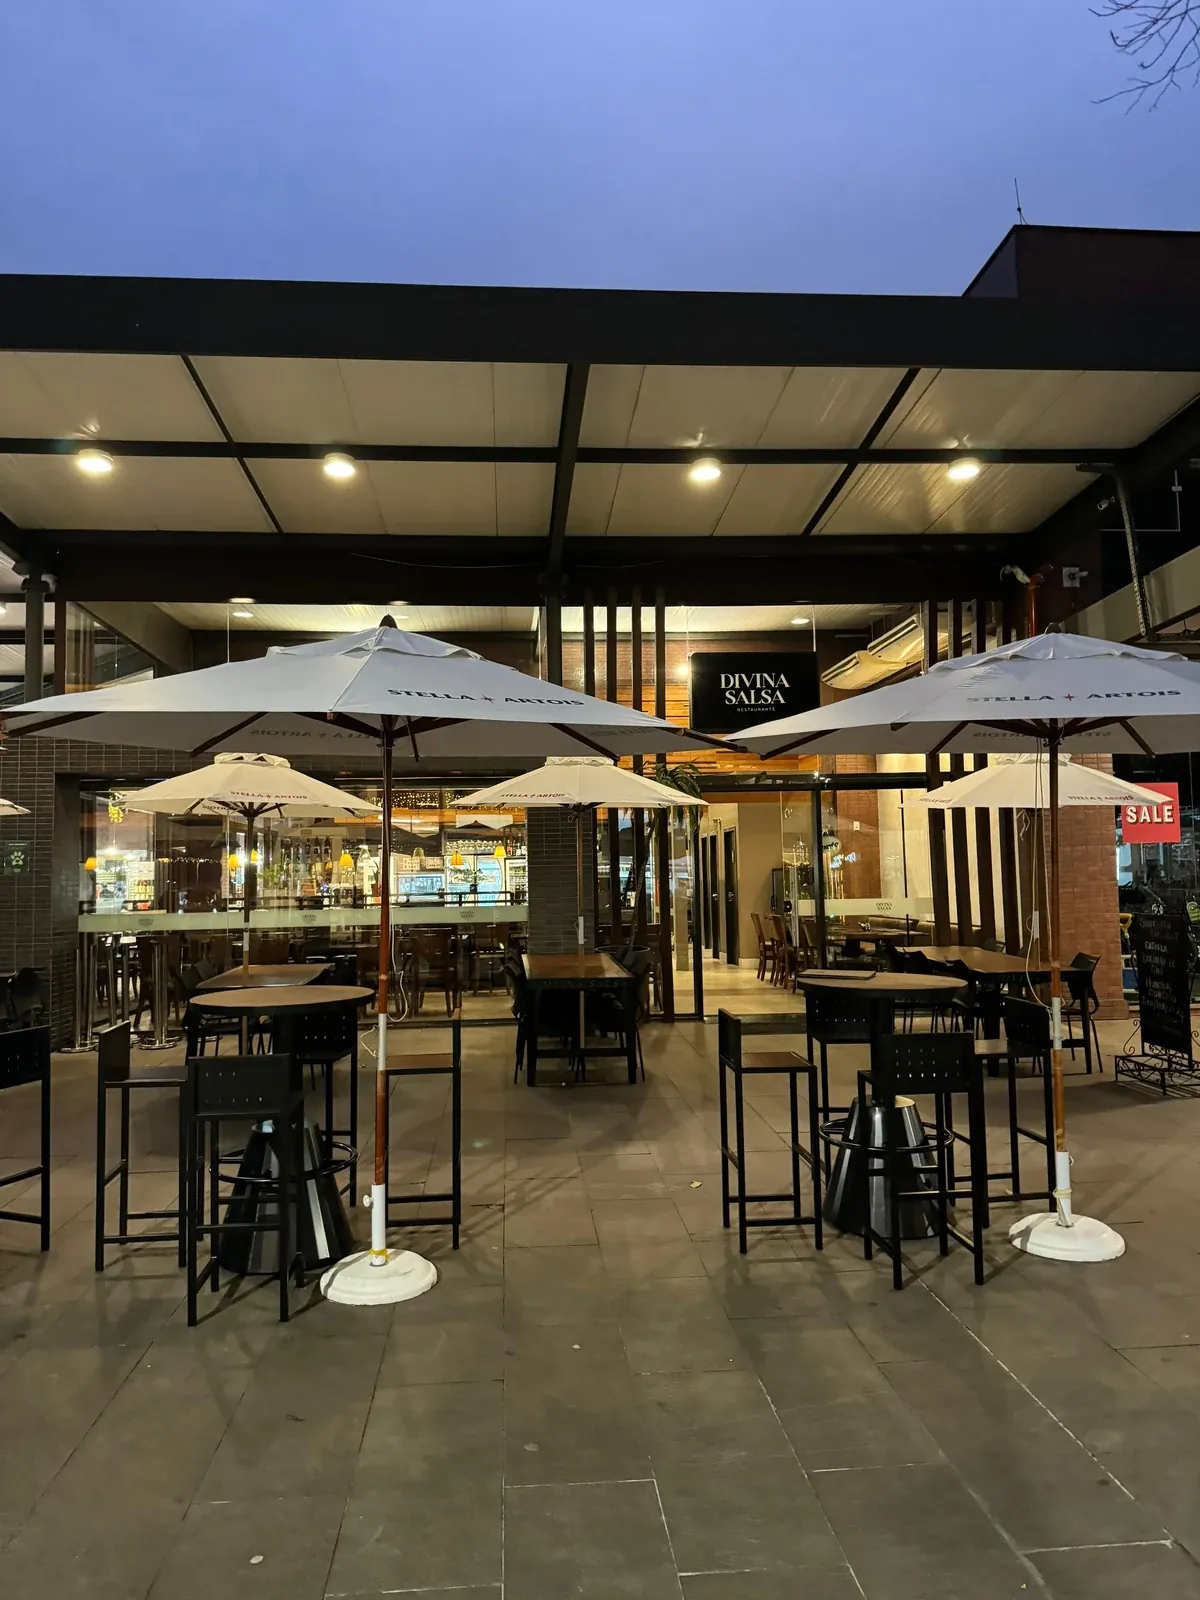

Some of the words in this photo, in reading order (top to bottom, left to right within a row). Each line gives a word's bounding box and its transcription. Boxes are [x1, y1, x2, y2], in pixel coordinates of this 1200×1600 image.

[720, 673, 790, 689] DIVINA
[387, 689, 476, 700] STELLA
[504, 697, 585, 706] ARTOIS
[725, 689, 786, 705] SALSA
[1087, 690, 1182, 700] ARTOIS
[230, 790, 264, 798] STELLA
[1126, 805, 1174, 824] SALE
